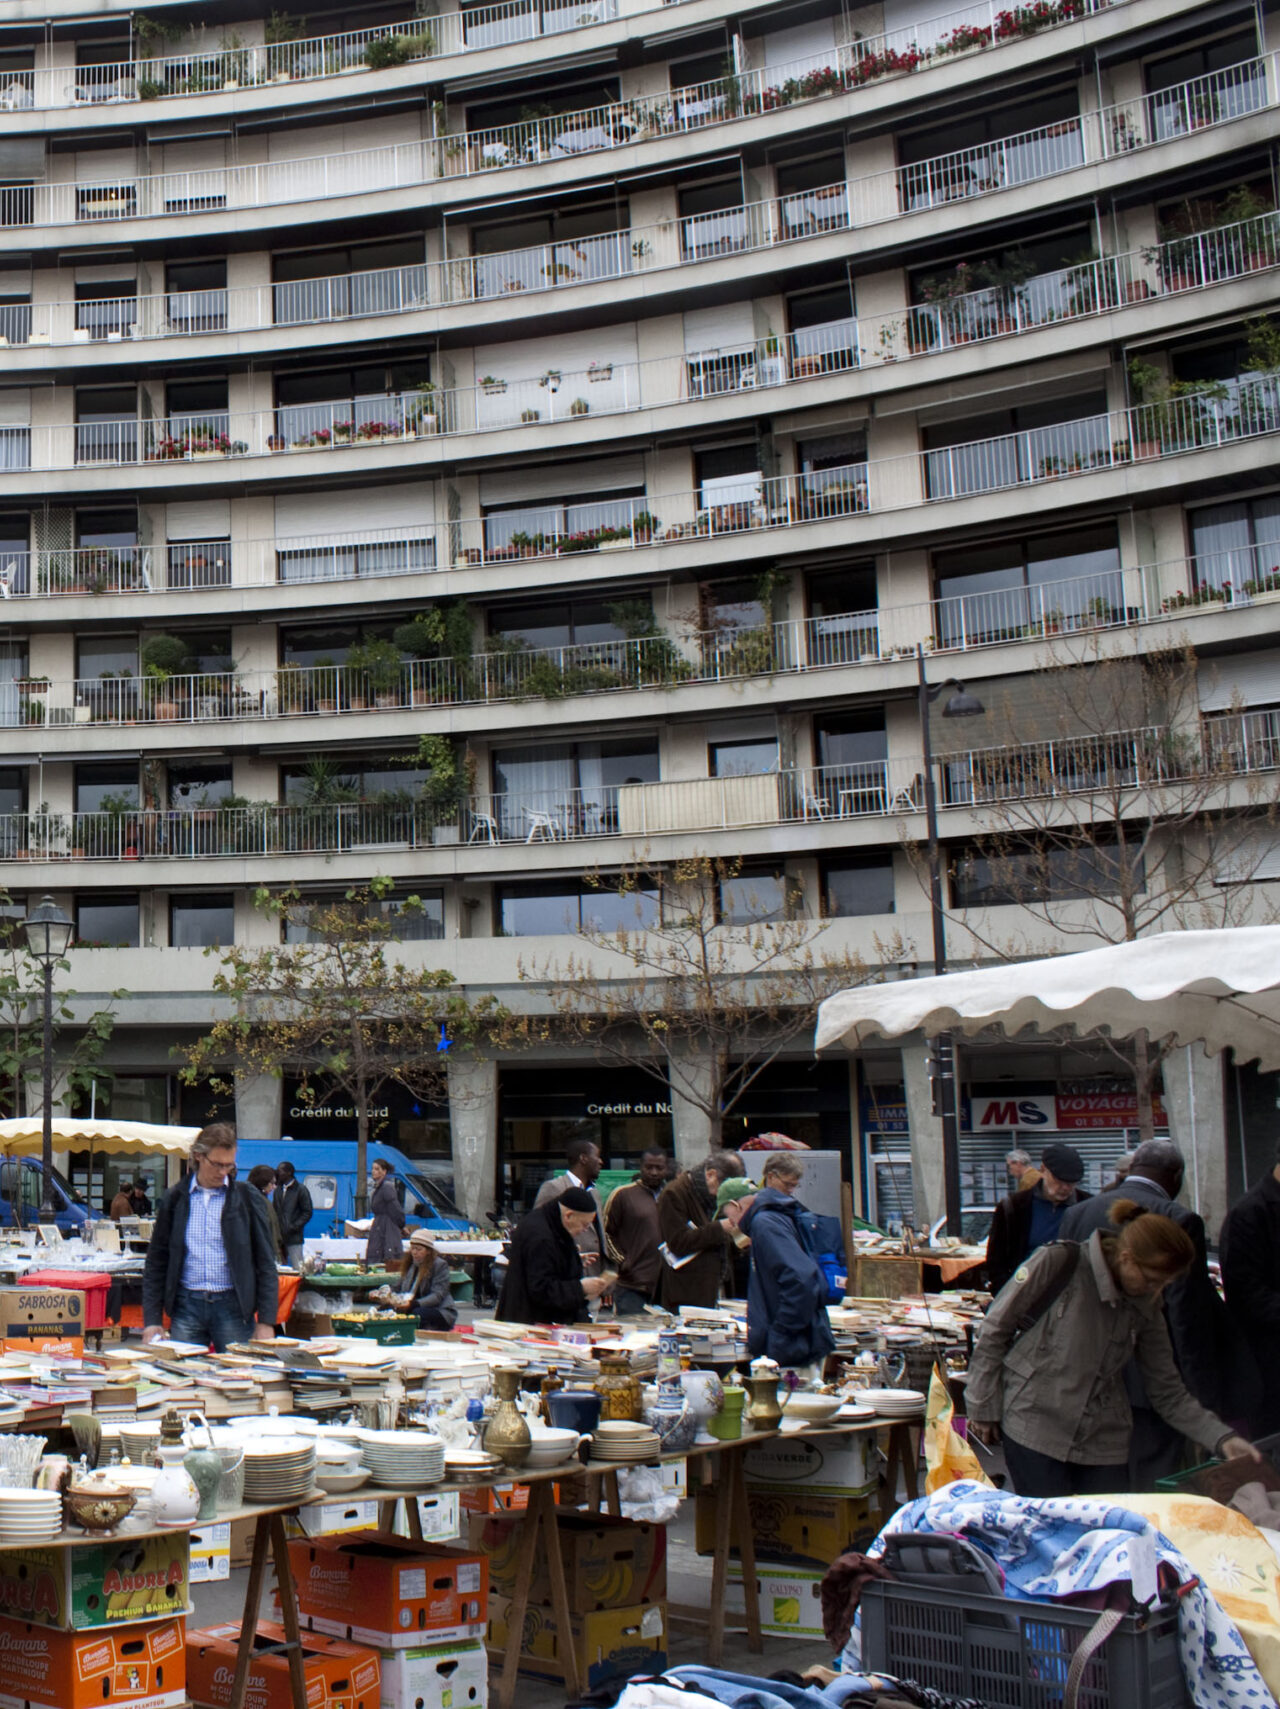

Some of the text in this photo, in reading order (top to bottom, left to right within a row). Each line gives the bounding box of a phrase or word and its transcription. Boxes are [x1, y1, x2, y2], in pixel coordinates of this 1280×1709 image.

[289, 1107, 332, 1118] Crédit
[586, 1103, 632, 1115] Crédit
[634, 1103, 652, 1114] du
[980, 1101, 1049, 1126] MS
[19, 1295, 66, 1310] SABROSA
[27, 1325, 64, 1335] BANANAS
[102, 1560, 185, 1595] ANDREA
[214, 1666, 267, 1688] Bane
